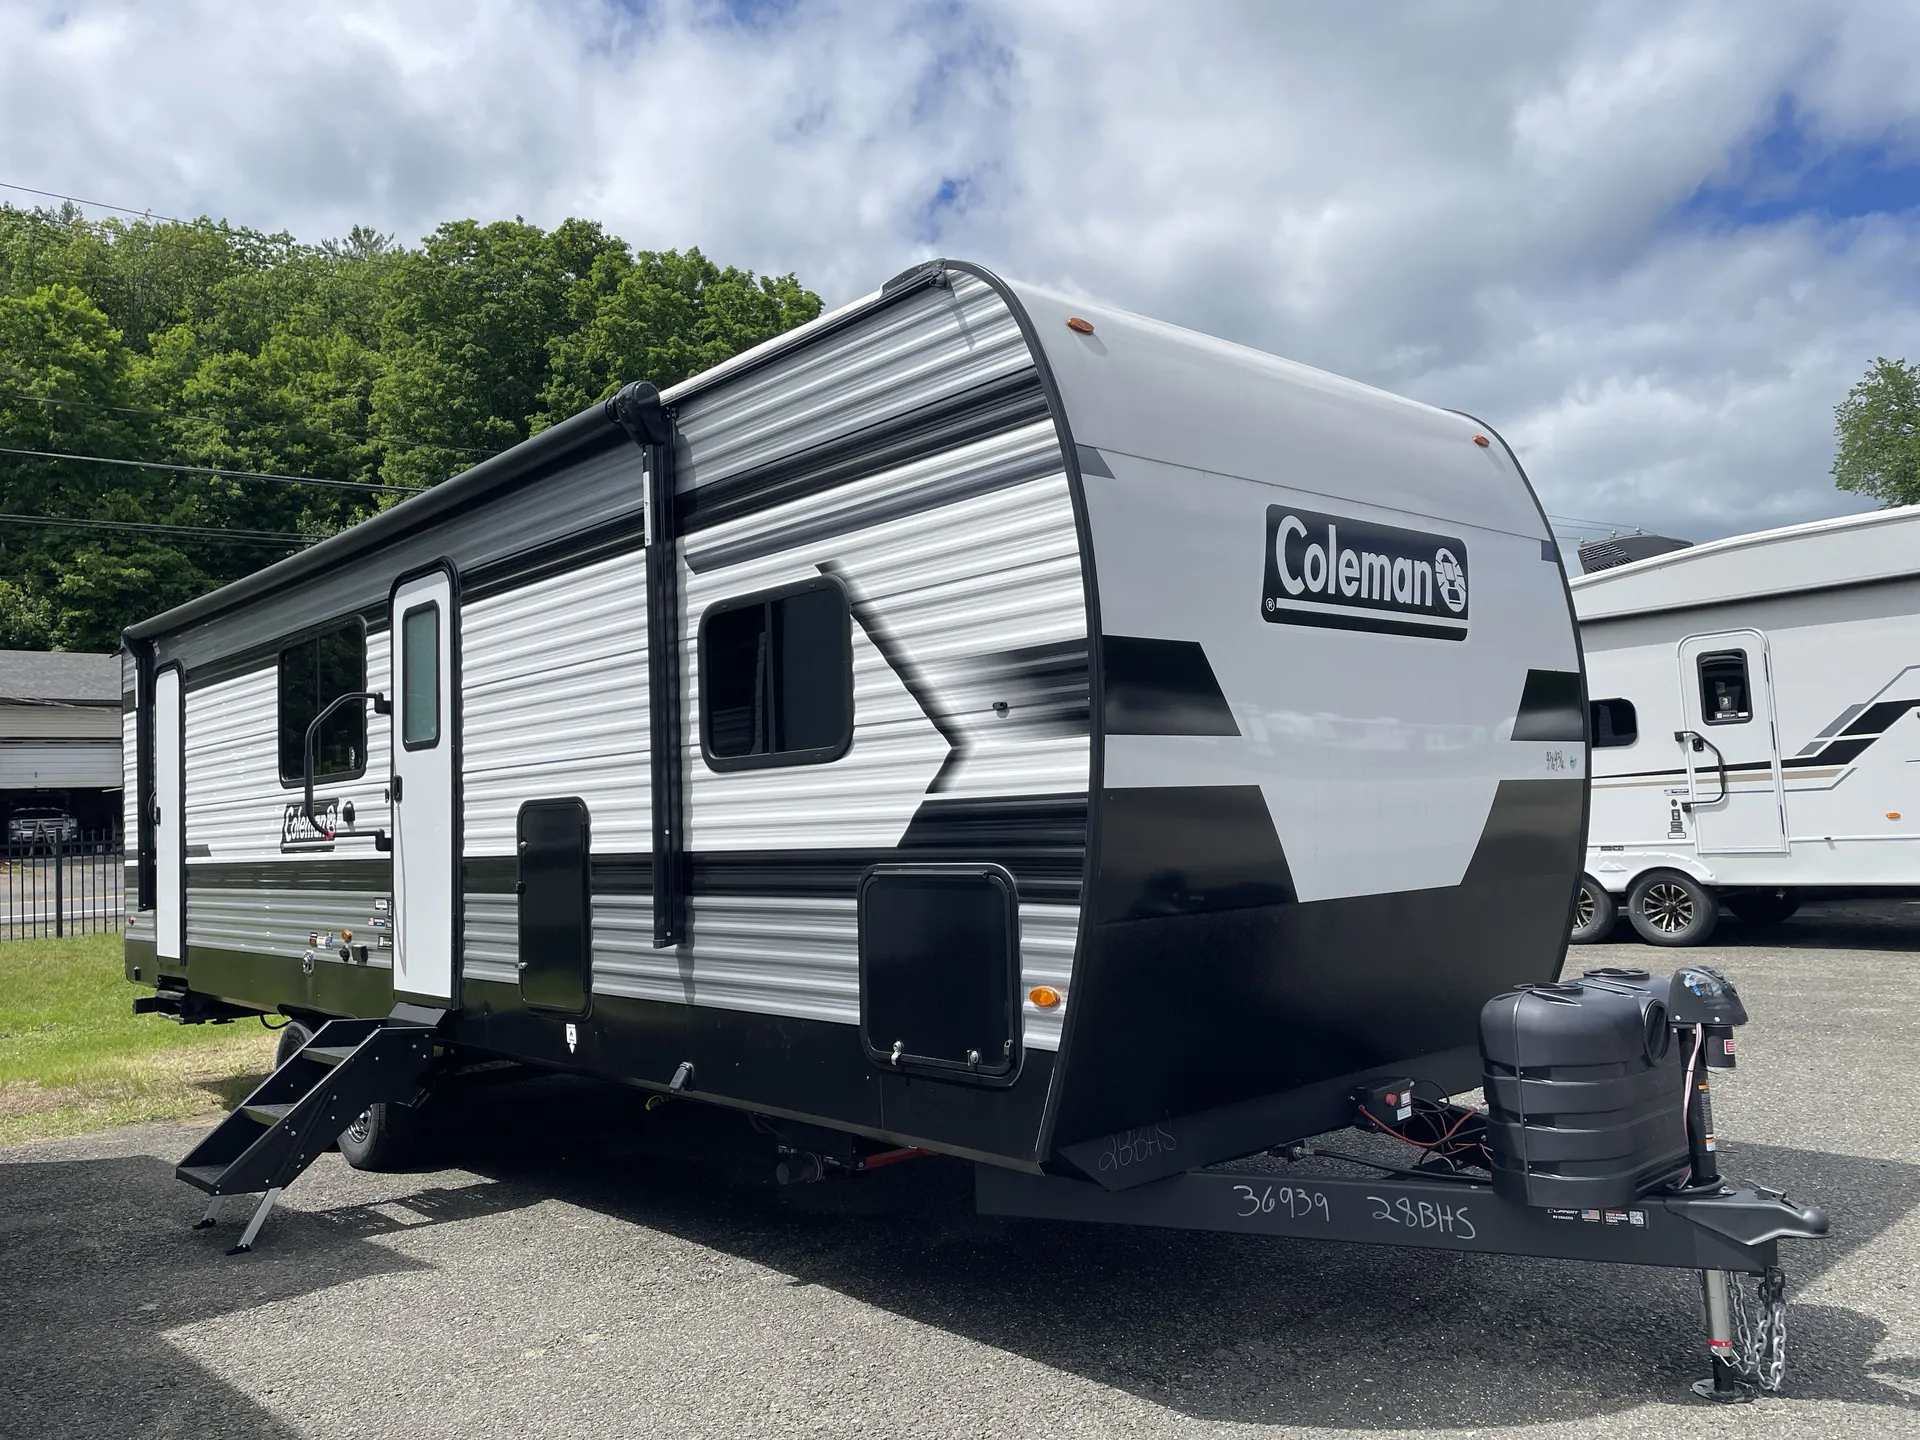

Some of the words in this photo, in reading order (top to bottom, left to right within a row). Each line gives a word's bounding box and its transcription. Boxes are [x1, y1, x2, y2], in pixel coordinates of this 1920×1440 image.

[1276, 514, 1433, 607] Coleman
[1233, 1184, 1330, 1222] 36939
[1366, 1196, 1477, 1240] 28BHS
